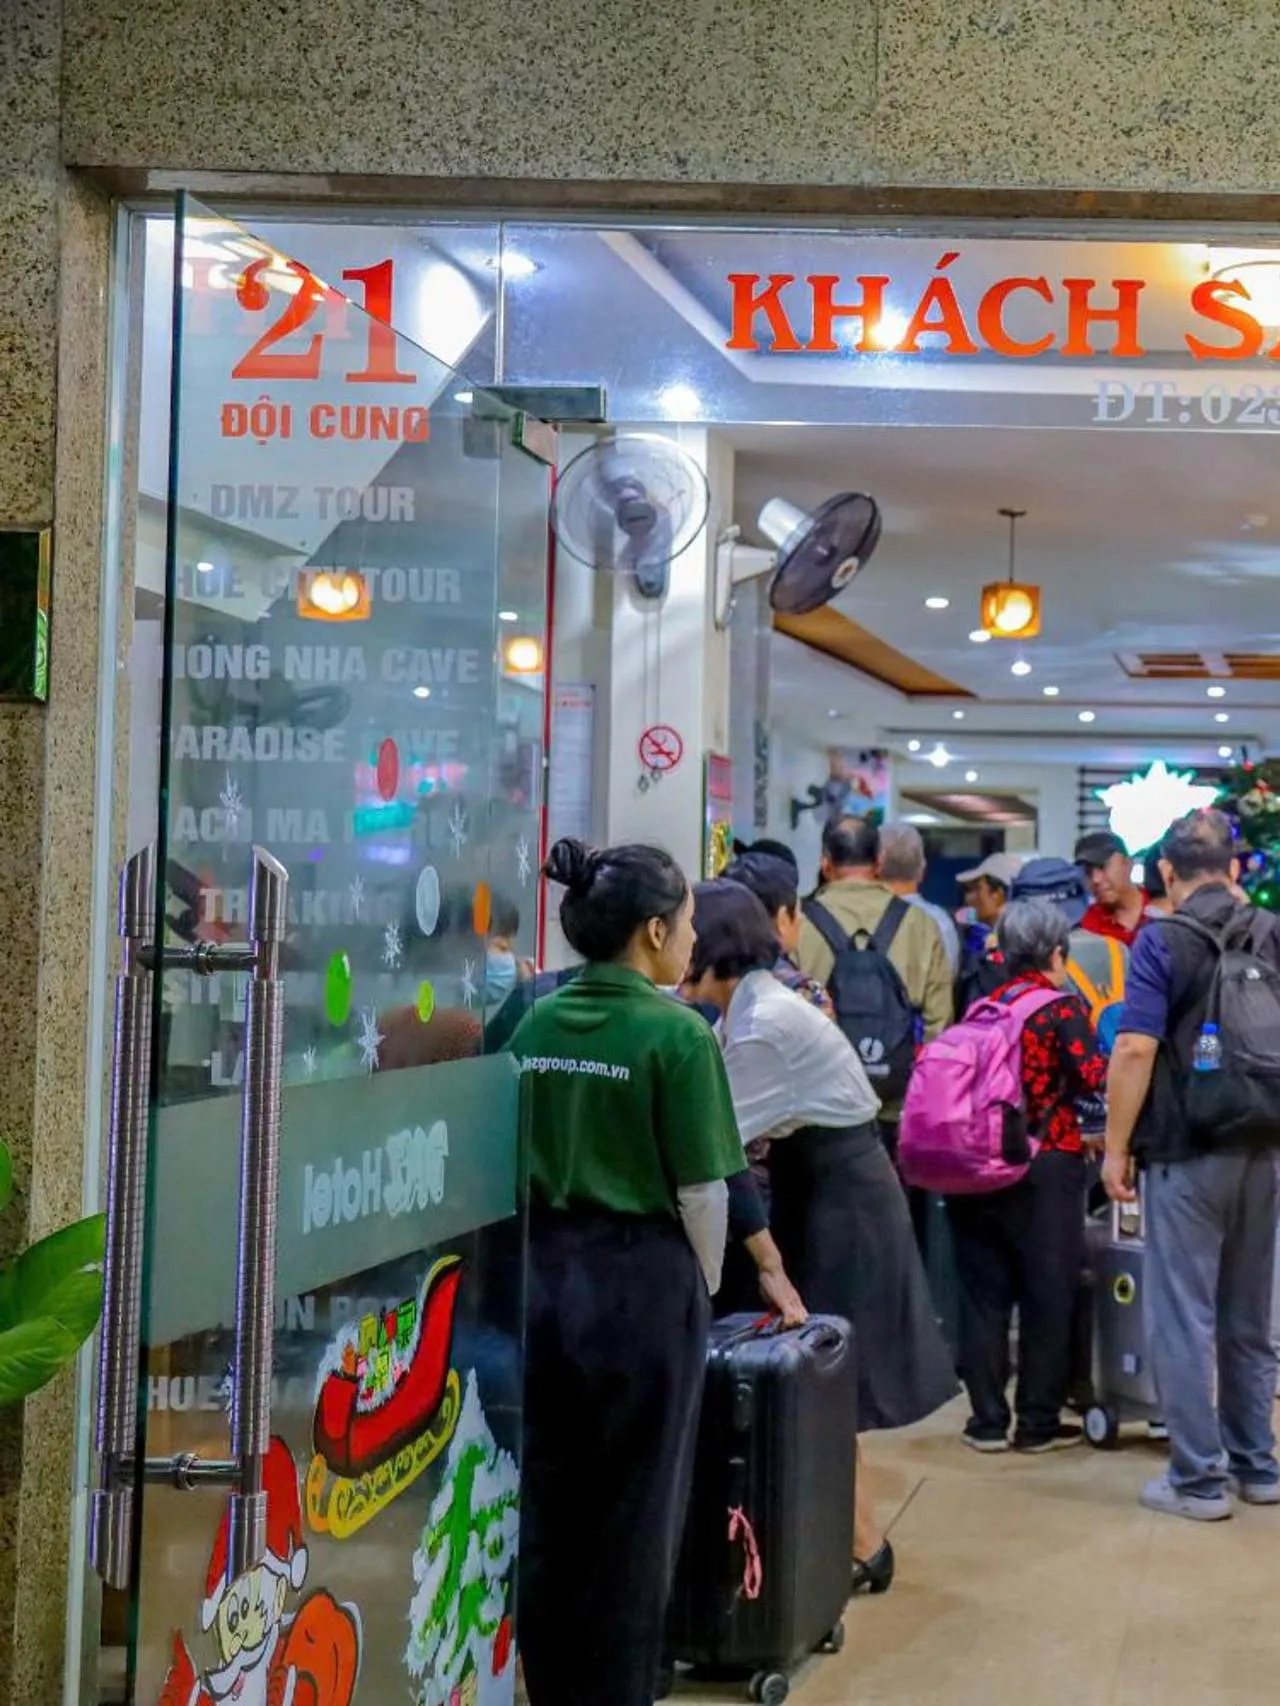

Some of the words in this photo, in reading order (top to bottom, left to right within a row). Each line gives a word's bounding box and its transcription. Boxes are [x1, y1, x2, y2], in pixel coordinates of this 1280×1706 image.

[232, 258, 417, 383] 21
[725, 252, 1146, 357] KHÁCH
[221, 394, 291, 446] ĐỘI
[309, 404, 430, 443] CUNG
[211, 485, 300, 521] DMZ
[314, 486, 415, 523] TOUR
[364, 566, 462, 603] TOUR
[285, 646, 367, 683] NHA
[382, 648, 478, 684] CAVE
[173, 726, 347, 763] ARADISE
[172, 804, 252, 843] ACH
[267, 808, 329, 844] MA
